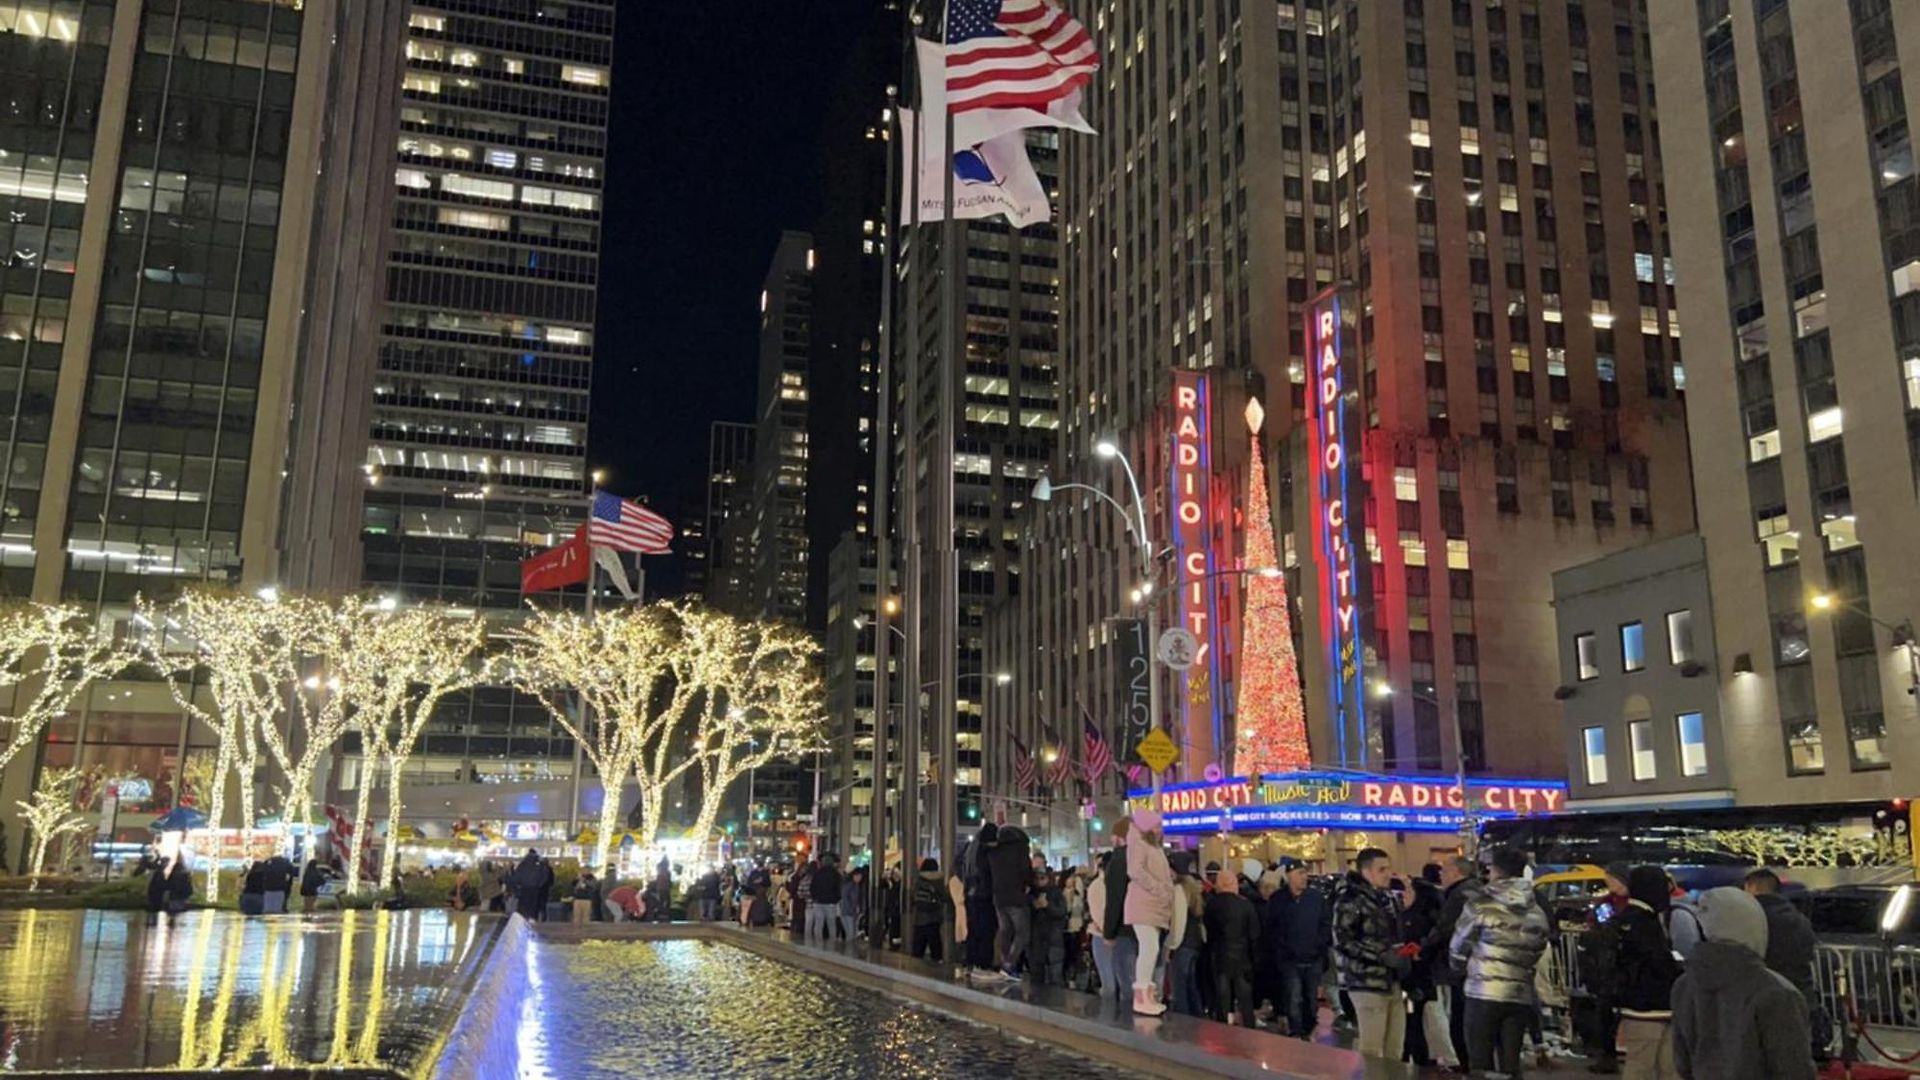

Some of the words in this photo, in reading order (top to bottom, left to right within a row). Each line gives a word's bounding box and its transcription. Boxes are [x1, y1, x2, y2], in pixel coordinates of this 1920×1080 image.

[1178, 386, 1202, 524] RADIO
[1320, 311, 1341, 469] RADIO
[1328, 499, 1355, 634] CITY
[1162, 788, 1207, 813] RADIO
[1213, 782, 1253, 808] CITY
[1263, 784, 1311, 805] Music
[1364, 783, 1464, 808] RADIO
[1484, 787, 1560, 811] CITY
[1269, 811, 1330, 820] ROCKETTES
[1340, 812, 1362, 820] NOW
[1366, 813, 1406, 822] PLAYING
[1417, 813, 1437, 823] THIS
[1440, 814, 1450, 823] IS
